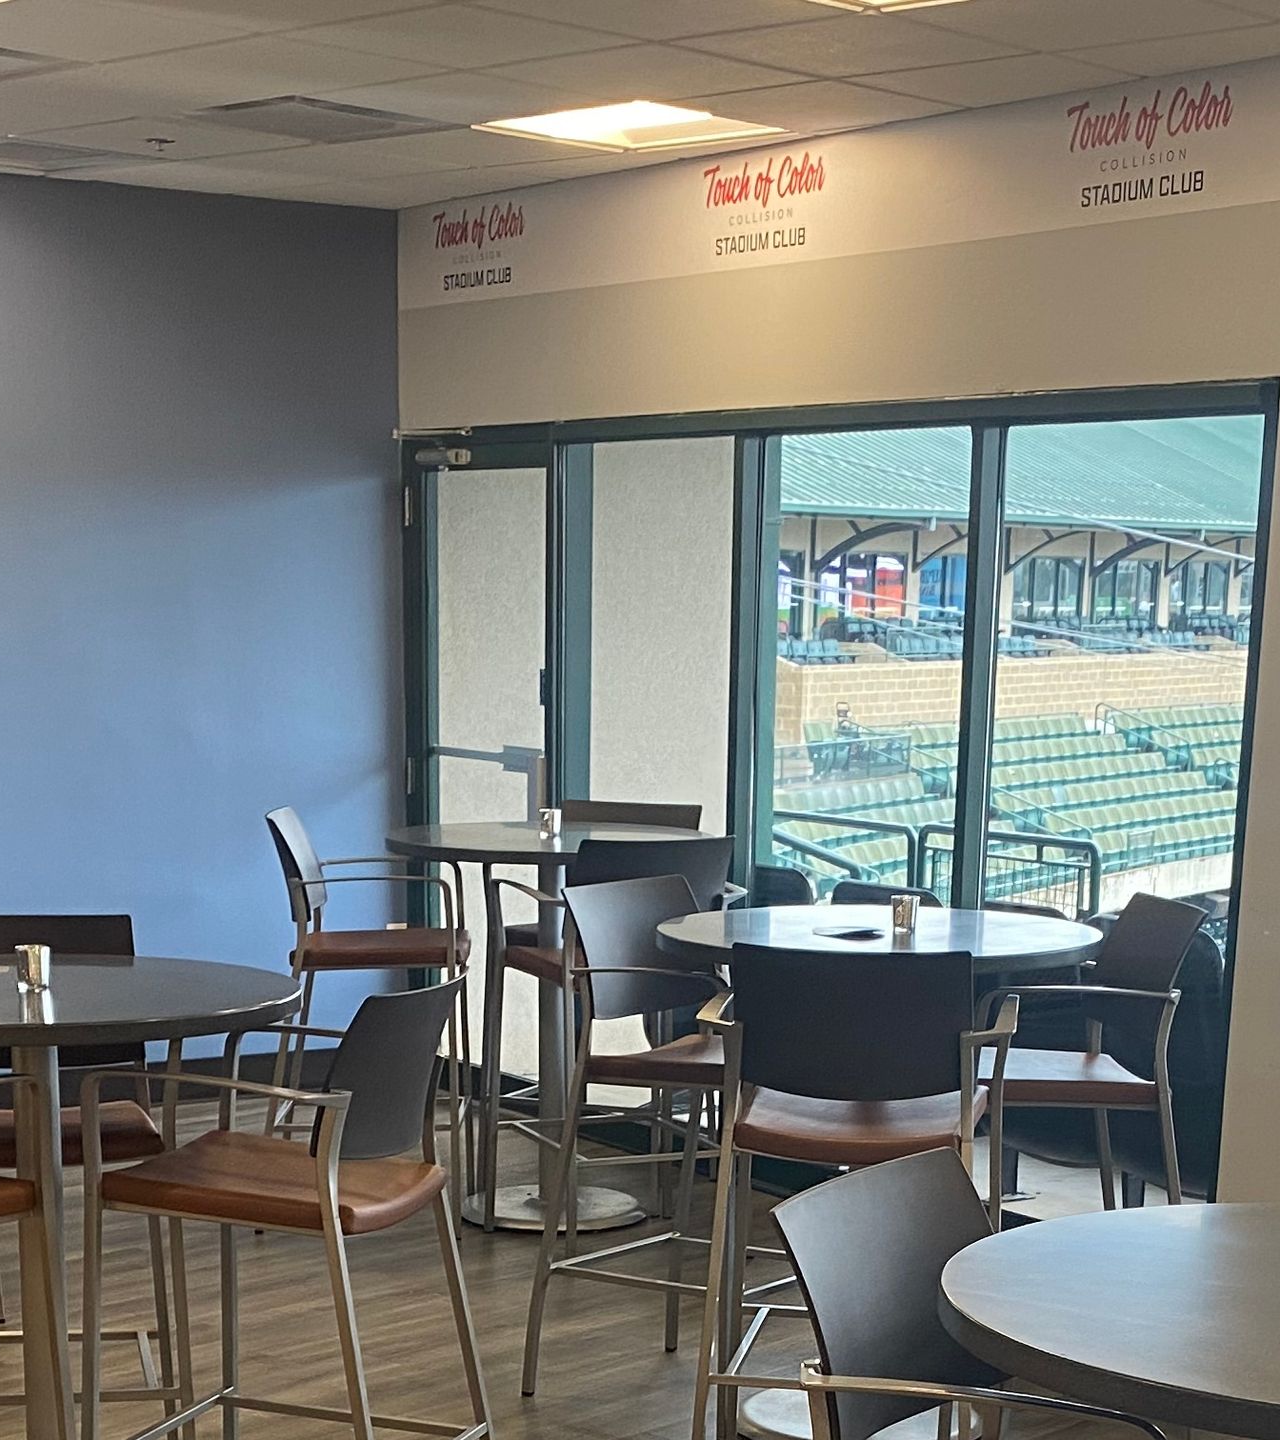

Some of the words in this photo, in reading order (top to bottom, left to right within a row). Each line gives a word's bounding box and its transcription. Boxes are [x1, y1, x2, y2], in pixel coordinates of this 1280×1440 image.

[1067, 96, 1131, 152] Touch
[1135, 89, 1163, 150] of
[1167, 81, 1233, 137] Color
[1100, 149, 1187, 172] COLLISION
[704, 161, 750, 208] Touch
[754, 157, 774, 208] of
[777, 151, 825, 198] Color
[1081, 178, 1153, 208] STADIUM
[1159, 170, 1204, 197] CLUB
[433, 208, 469, 248] Touch
[471, 206, 486, 250] of
[488, 202, 524, 241] Color
[728, 208, 793, 226] COLLISION
[715, 231, 769, 256] STADIUM
[773, 227, 806, 248] CLUB
[443, 270, 484, 291] STADIUM
[486, 267, 511, 285] CLUB
